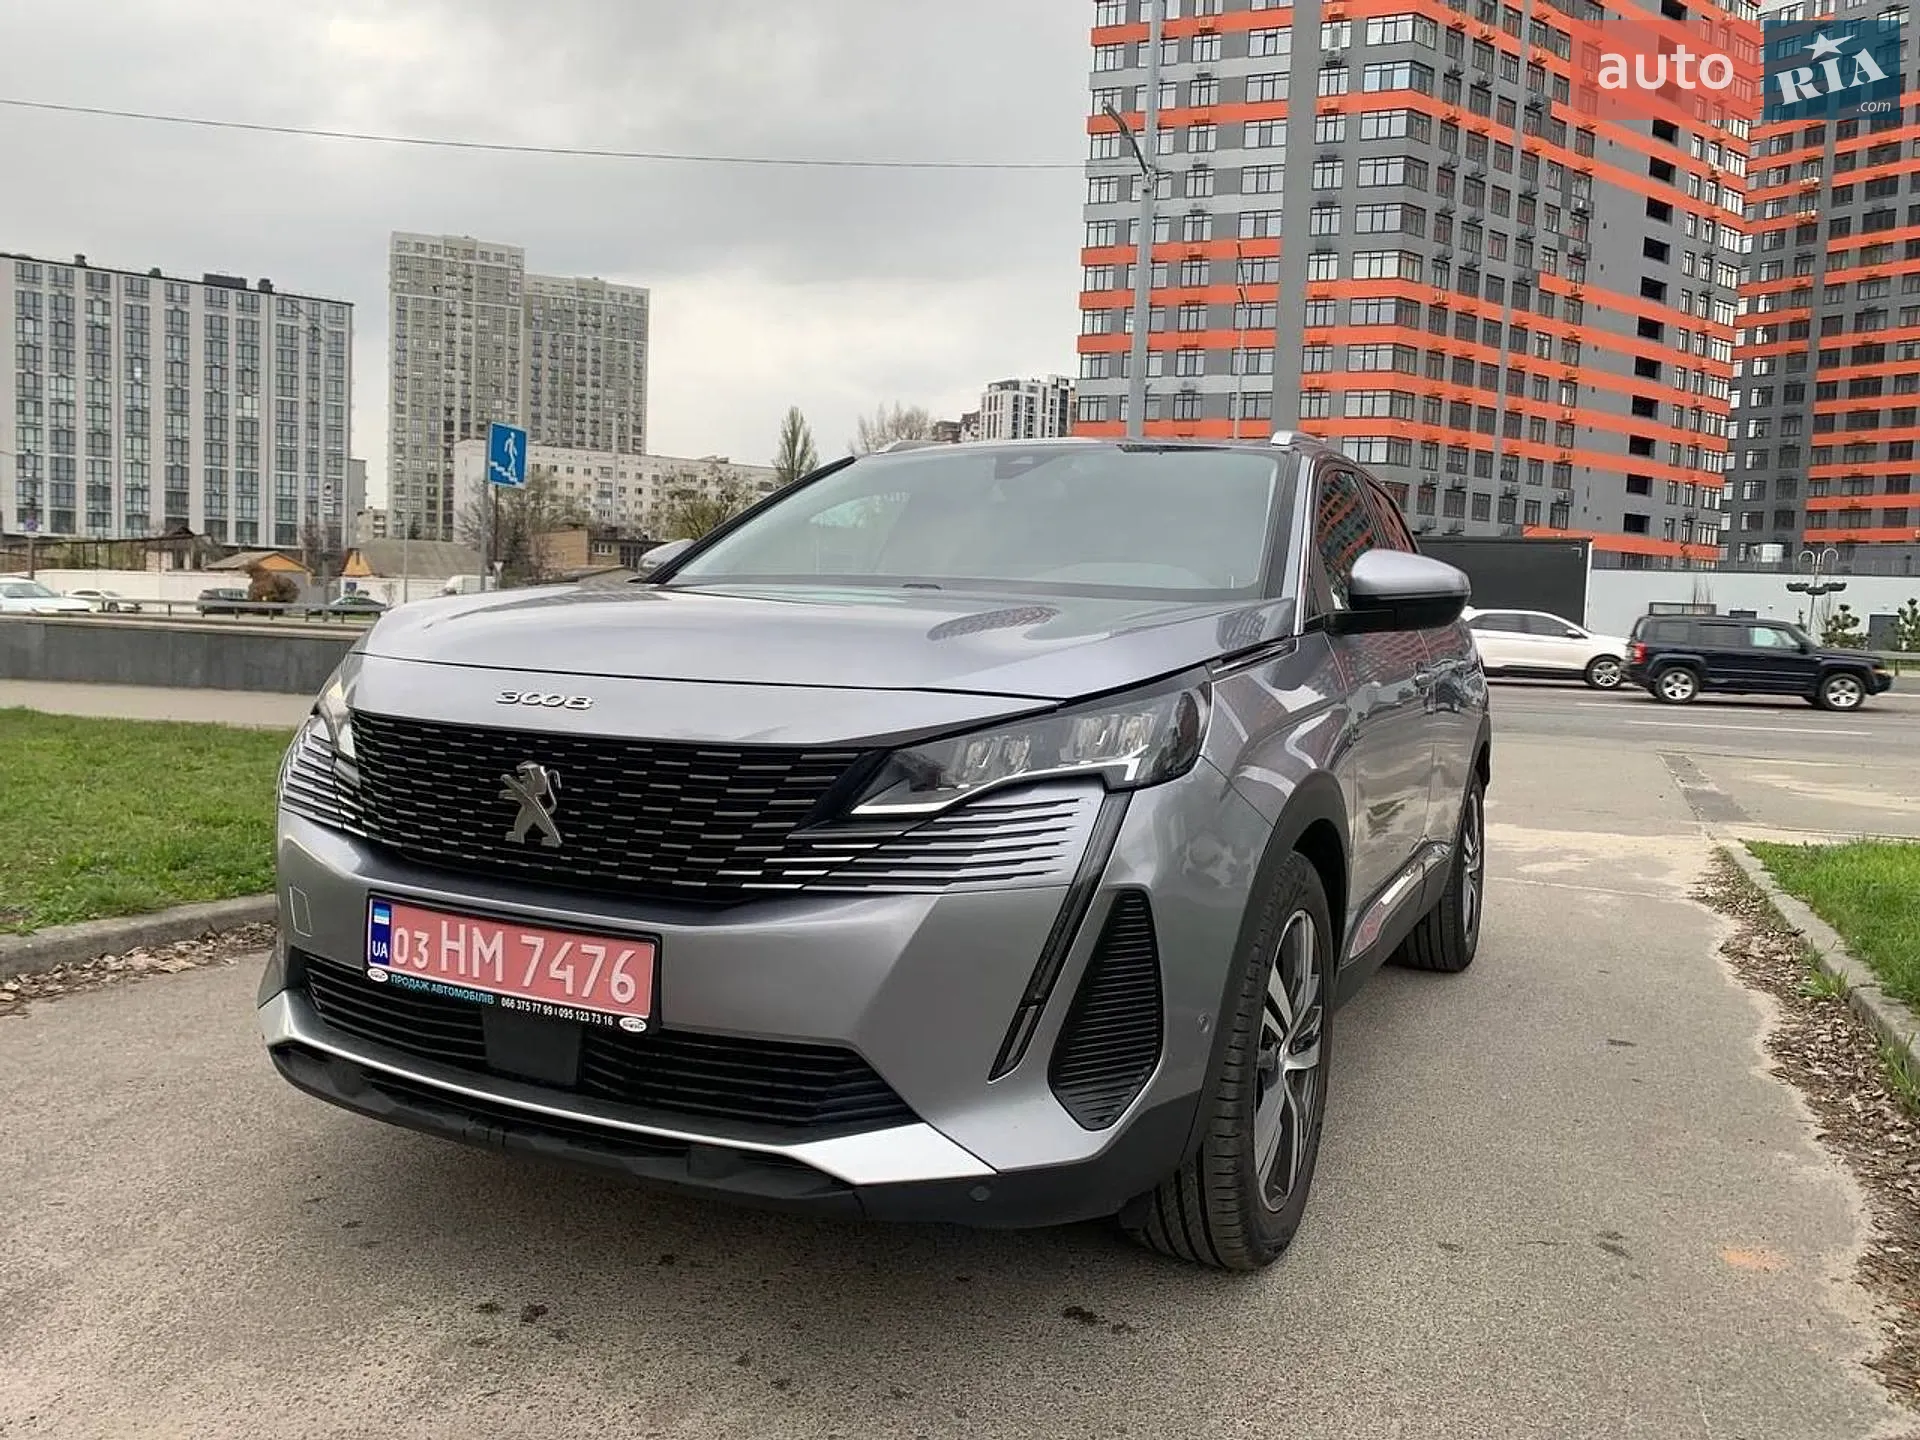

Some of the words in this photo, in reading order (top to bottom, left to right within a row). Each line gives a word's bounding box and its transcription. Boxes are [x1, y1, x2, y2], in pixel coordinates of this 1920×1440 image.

[496, 690, 593, 710] 3008
[372, 940, 389, 959] UA
[393, 927, 429, 970] 03
[440, 920, 504, 983] HM
[520, 935, 637, 1004] 7476
[391, 973, 430, 991] ПРОДАЖ
[431, 983, 495, 1005] АВТОМОБІЛІВ
[501, 996, 516, 1010] 066
[516, 999, 531, 1011] 375
[531, 1002, 541, 1013] 77
[542, 1004, 553, 1016] 99
[558, 1007, 573, 1019] 095
[575, 1010, 590, 1022] 123
[591, 1013, 601, 1024] 73
